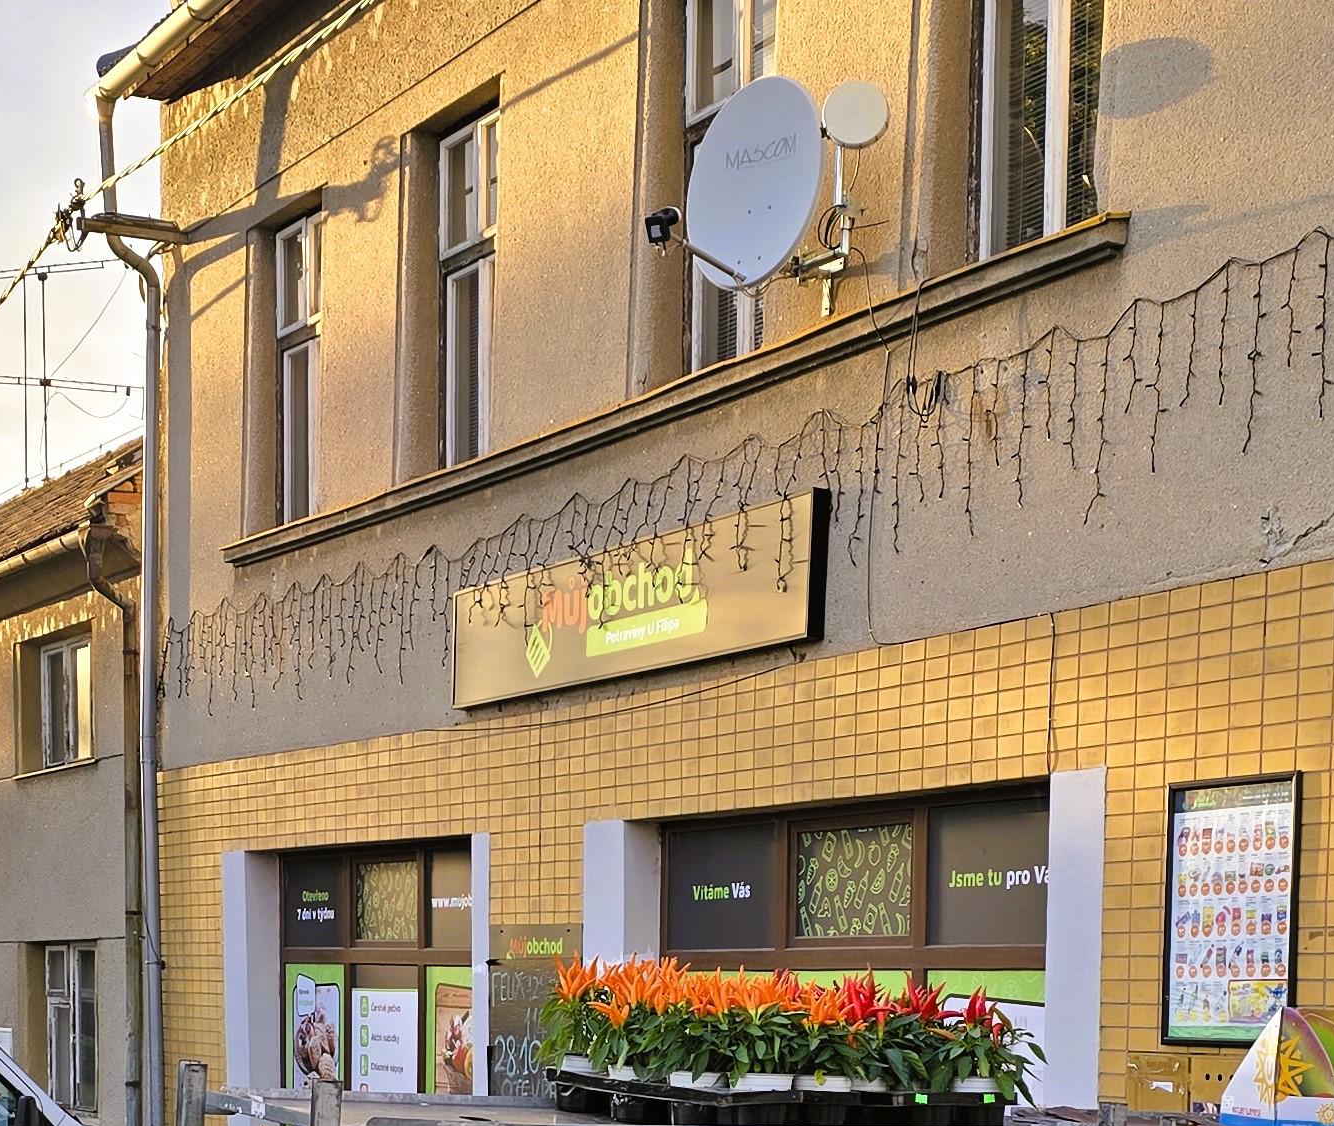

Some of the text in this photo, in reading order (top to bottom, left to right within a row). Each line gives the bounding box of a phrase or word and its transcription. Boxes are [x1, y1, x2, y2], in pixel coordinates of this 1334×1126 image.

[725, 134, 797, 171] MASCOM
[605, 625, 646, 645] Potraviny
[647, 622, 655, 635] U
[949, 870, 984, 888] Jsme
[987, 868, 1003, 887] tu
[1006, 869, 1031, 890] pro
[302, 889, 329, 902] Otevřeno
[731, 881, 751, 899] Vás
[296, 908, 302, 920] 7
